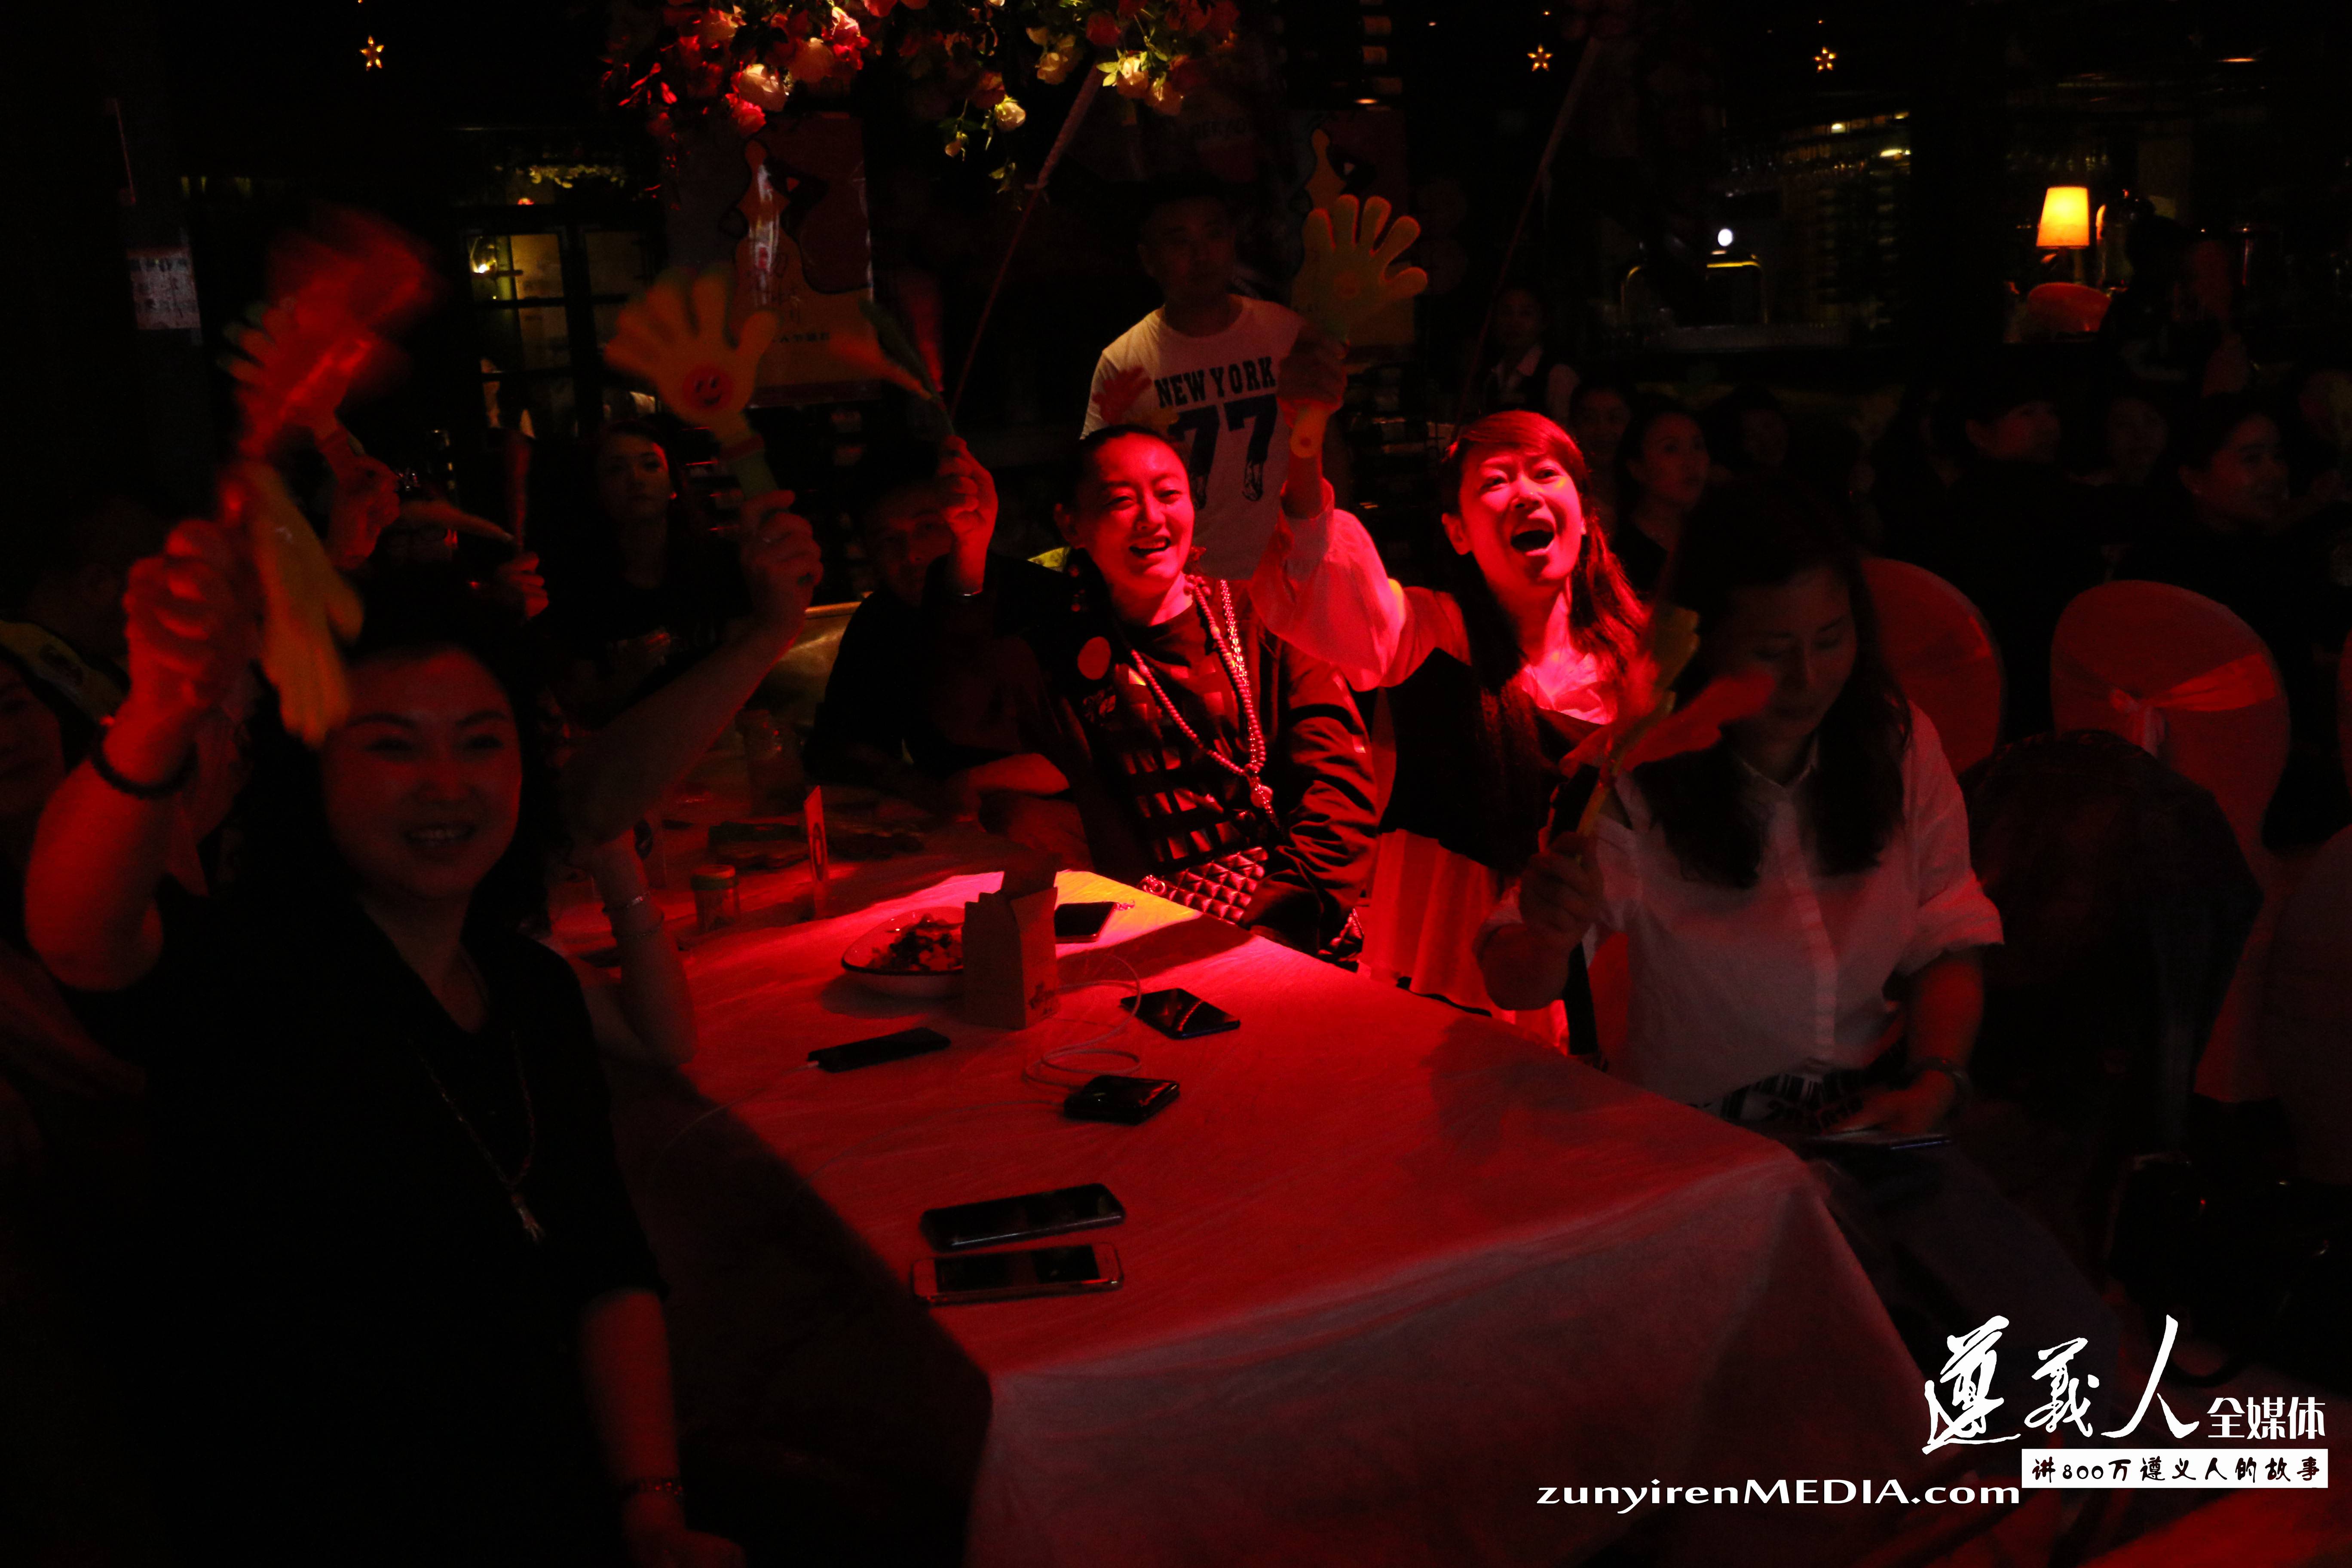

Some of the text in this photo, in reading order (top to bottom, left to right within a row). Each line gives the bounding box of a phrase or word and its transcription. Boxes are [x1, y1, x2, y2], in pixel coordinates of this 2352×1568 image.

[1155, 357, 1277, 407] NEW YORK
[1169, 394, 1278, 501] 77
